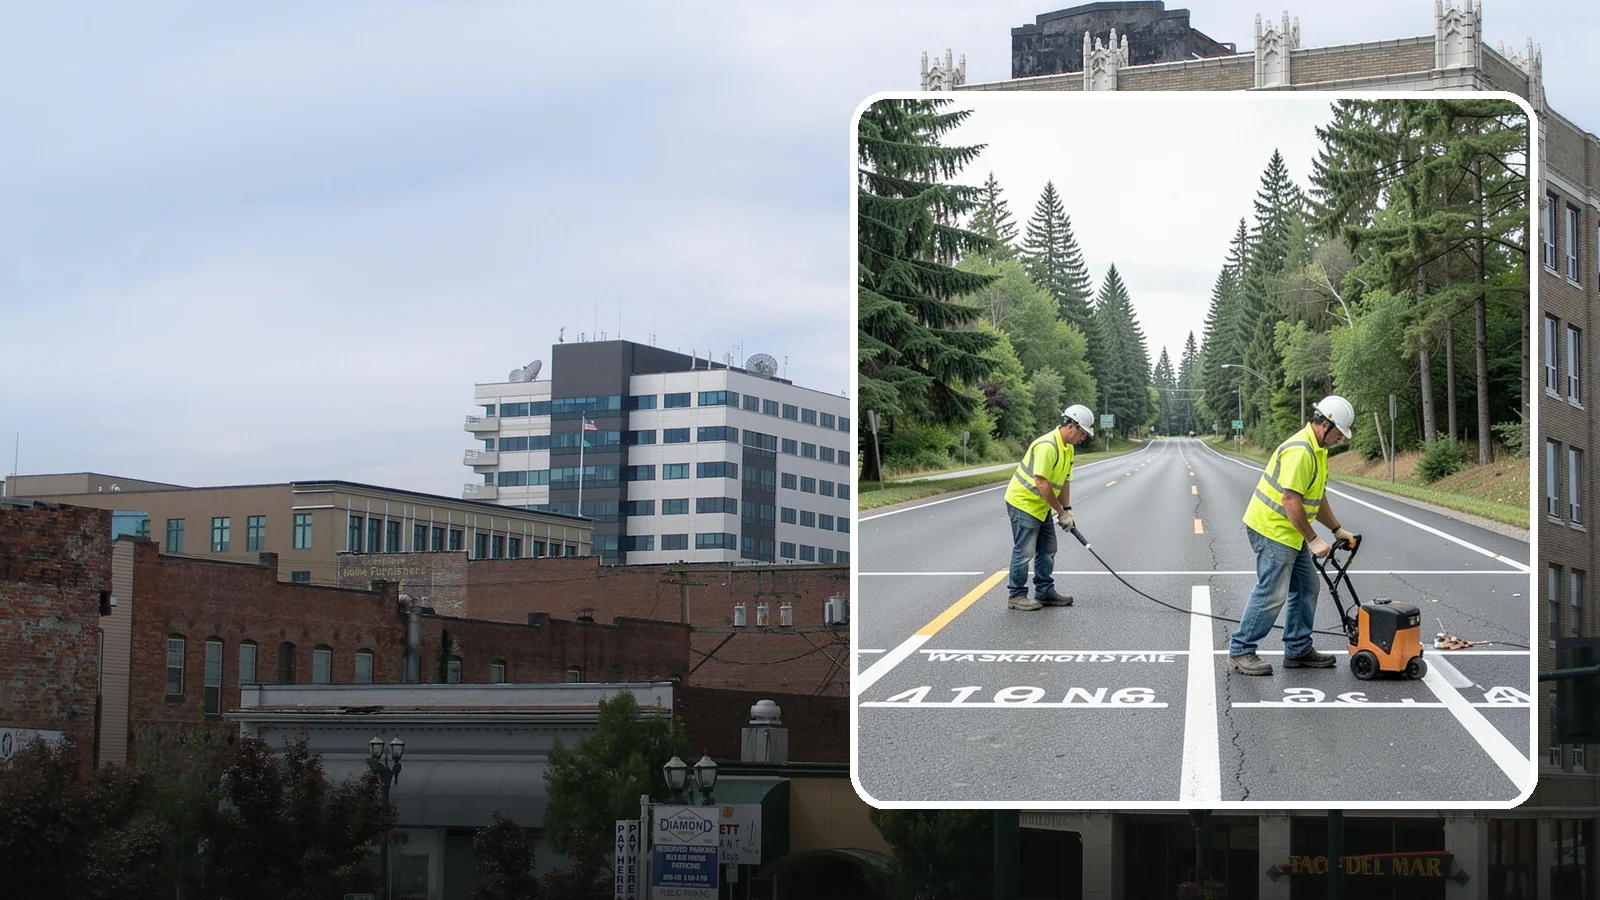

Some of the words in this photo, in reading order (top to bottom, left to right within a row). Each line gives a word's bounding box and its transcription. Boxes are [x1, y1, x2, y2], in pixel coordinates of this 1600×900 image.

[370, 566, 426, 577] Furnishers
[660, 818, 713, 833] DIAMOND
[1022, 815, 1070, 827] BUILDING
[617, 824, 625, 852] PAY
[628, 824, 637, 852] PAY
[656, 845, 688, 853] RESERVED
[689, 846, 716, 854] PARKING
[671, 862, 701, 870] PATRONS
[1289, 855, 1328, 875] TAC
[1346, 856, 1384, 875] DEL
[1392, 857, 1442, 877] MAR
[616, 856, 625, 894] HERE
[627, 855, 637, 893] HERE
[660, 888, 682, 897] PUBLIC
[683, 889, 710, 898] PARKING
